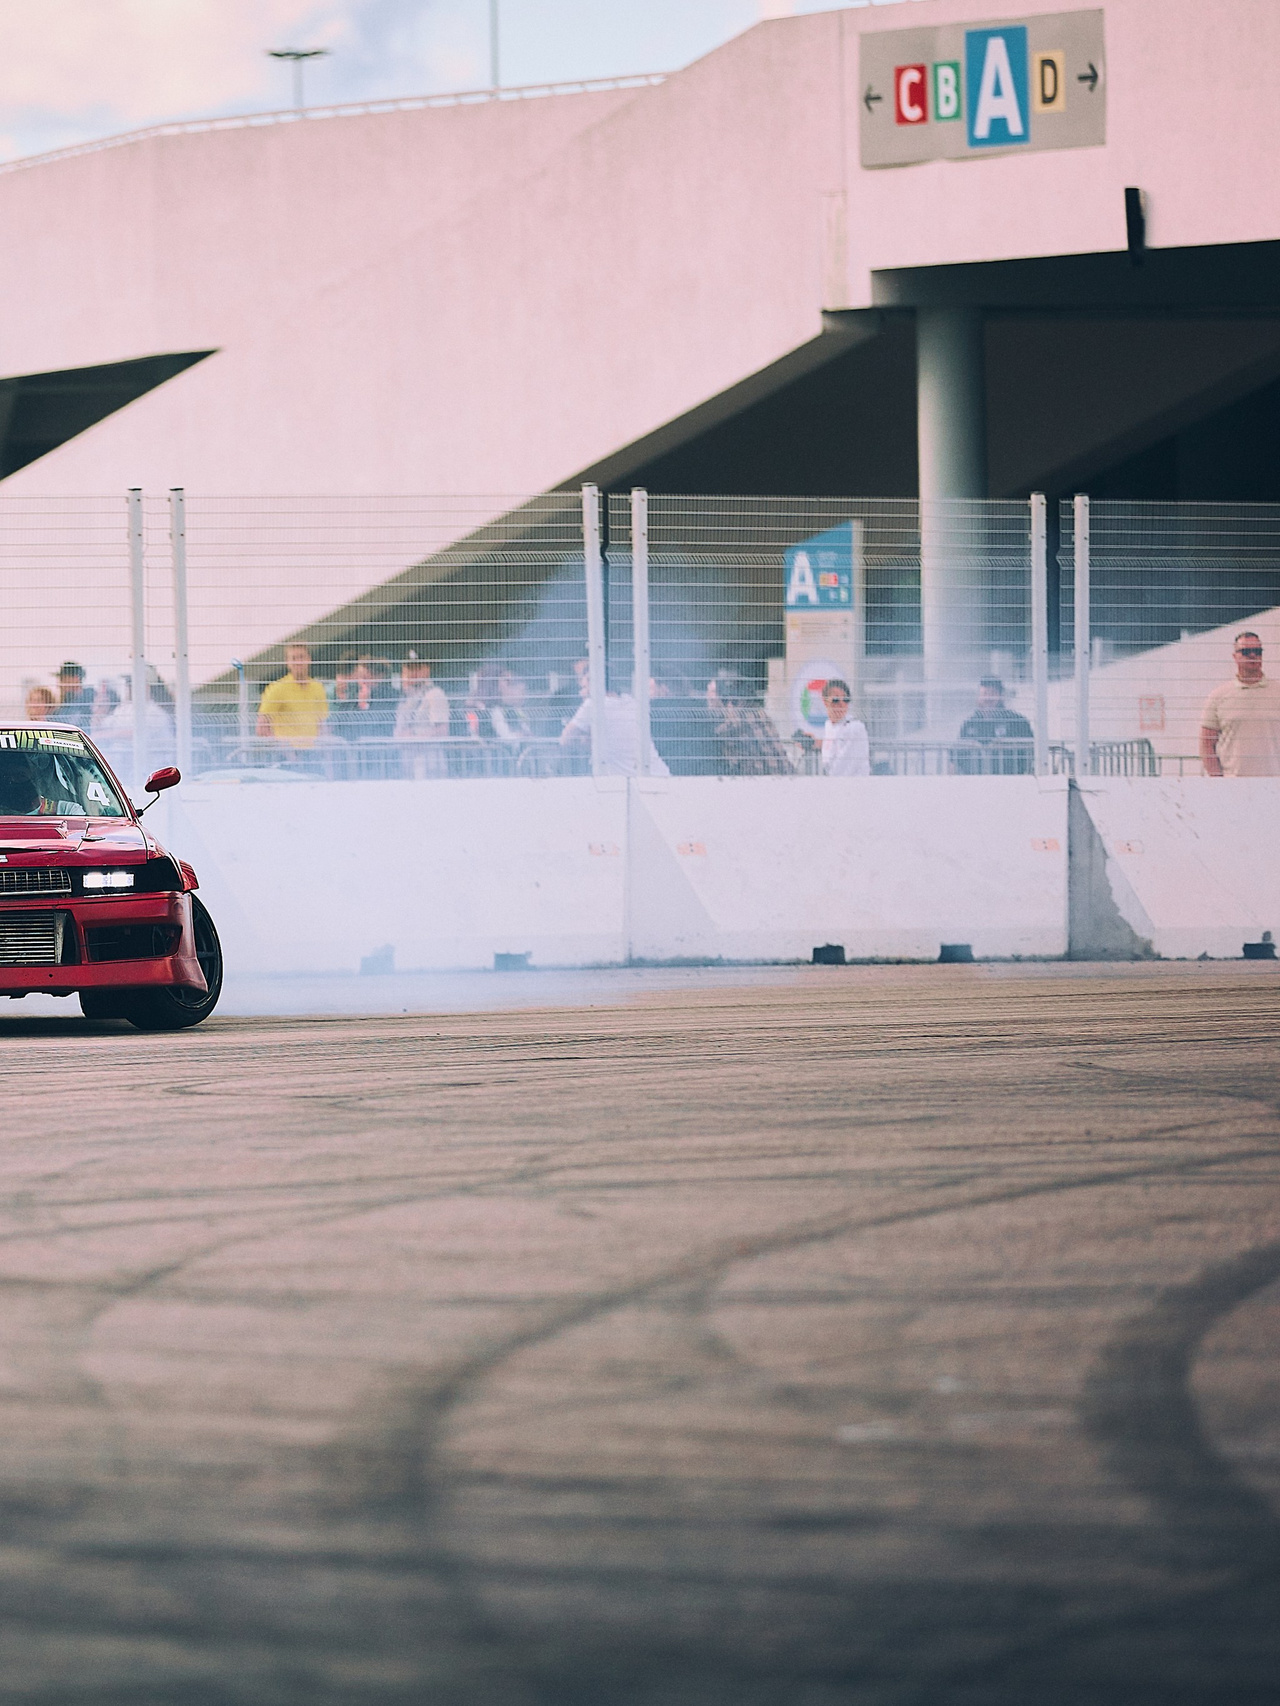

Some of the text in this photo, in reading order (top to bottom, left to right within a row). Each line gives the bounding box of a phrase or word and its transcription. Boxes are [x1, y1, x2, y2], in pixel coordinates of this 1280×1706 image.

[899, 36, 1058, 139] C B A D
[787, 551, 819, 605] A
[86, 781, 110, 806] 4
